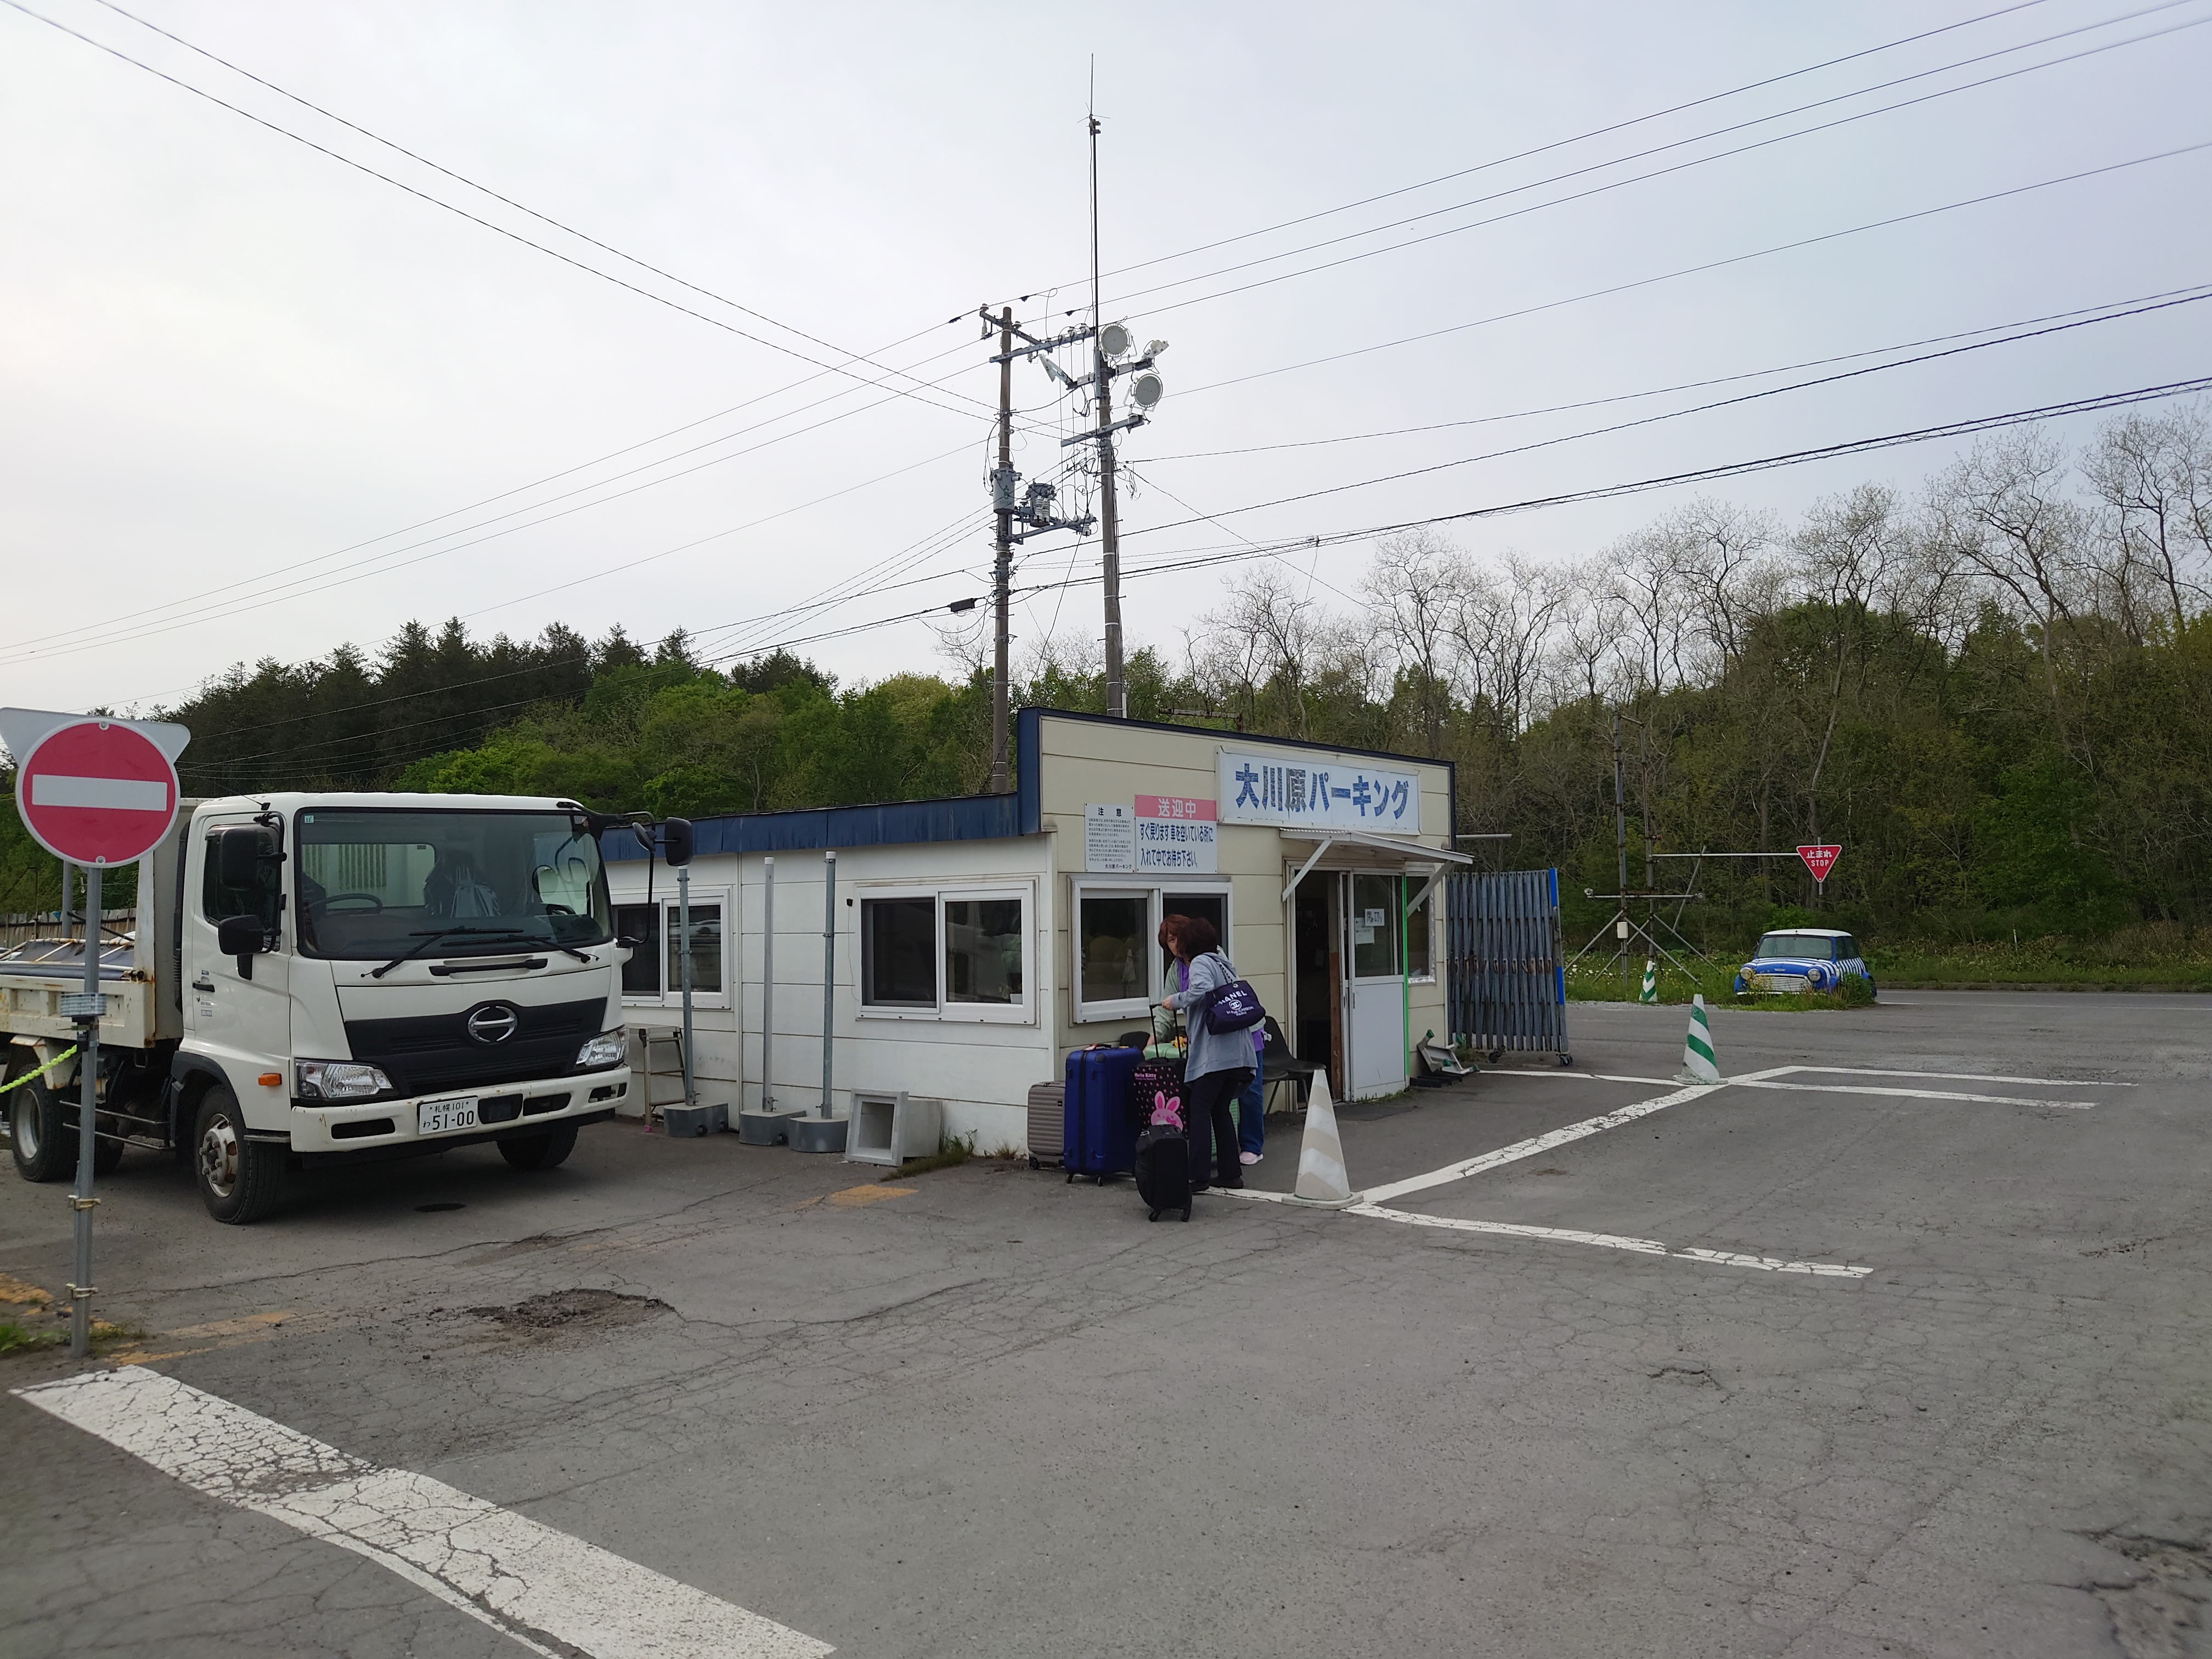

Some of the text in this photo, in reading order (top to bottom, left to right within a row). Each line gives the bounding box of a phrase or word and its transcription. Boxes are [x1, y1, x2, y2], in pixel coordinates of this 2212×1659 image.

[1235, 763, 1409, 820] 大川原パーキング
[1158, 798, 1196, 819] 送迎中
[1141, 848, 1198, 867] 入れて中でお待ち下さい。
[1806, 850, 1832, 859] 止まれ
[1214, 990, 1248, 1007] HANEL
[435, 1102, 464, 1113] 札幌 101
[432, 1110, 474, 1130] 51-00
